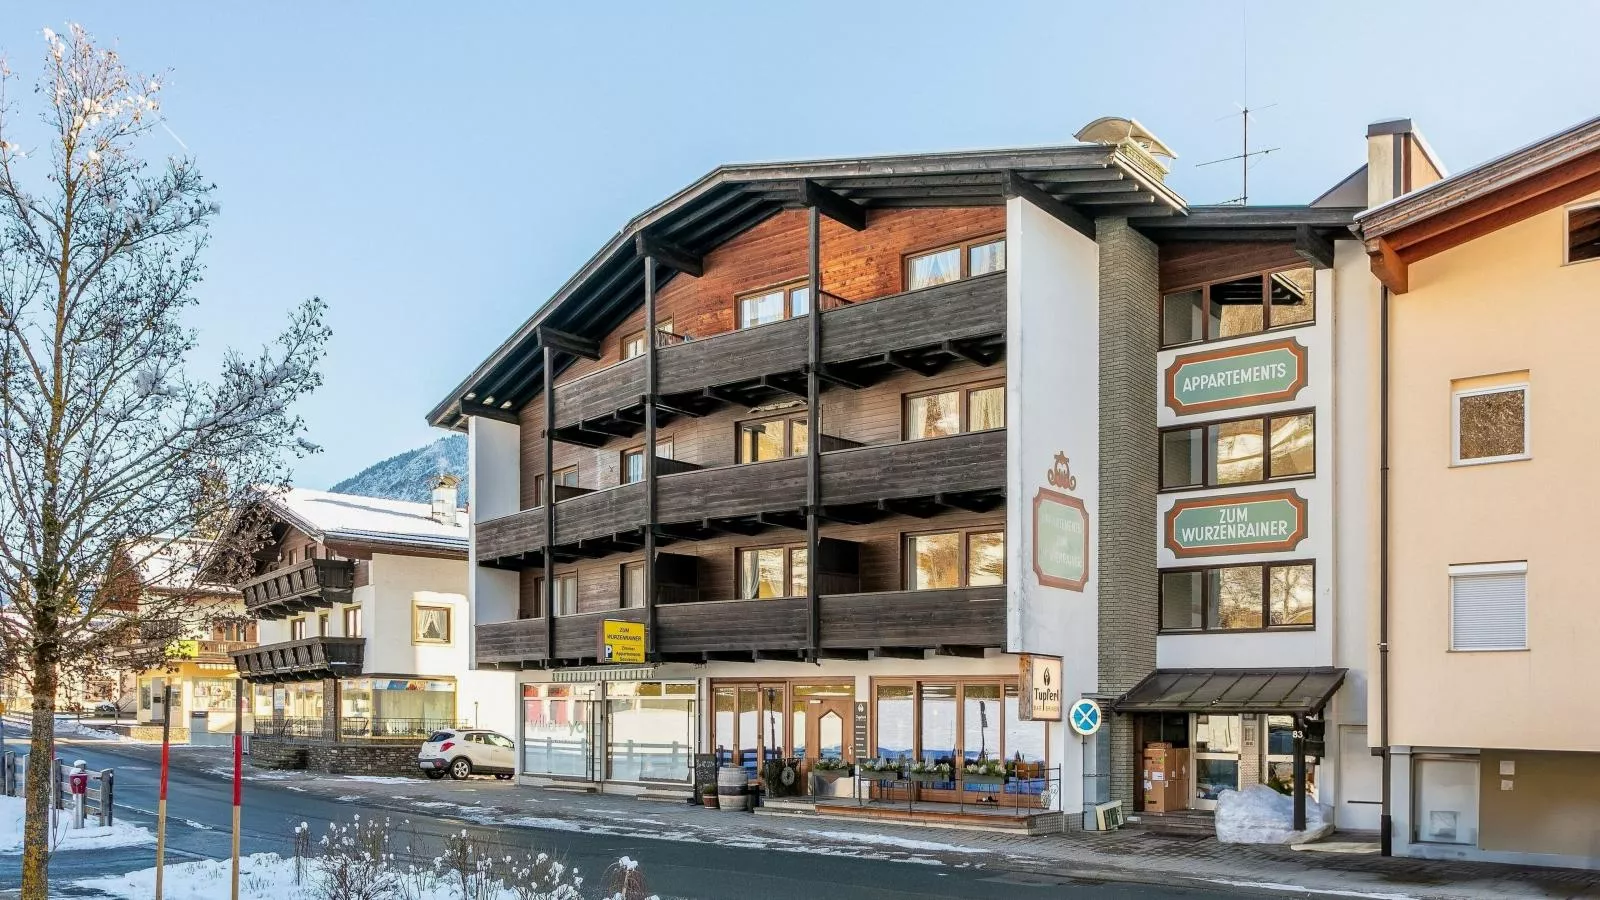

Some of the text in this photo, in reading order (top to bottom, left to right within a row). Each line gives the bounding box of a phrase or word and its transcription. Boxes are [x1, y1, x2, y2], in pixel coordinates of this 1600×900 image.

[1182, 363, 1287, 392] APPARTEMENTS
[1219, 507, 1248, 524] ZUM
[1181, 520, 1288, 542] WURZENRAINER
[1034, 688, 1059, 711] Tupferl
[1292, 730, 1303, 738] 83
